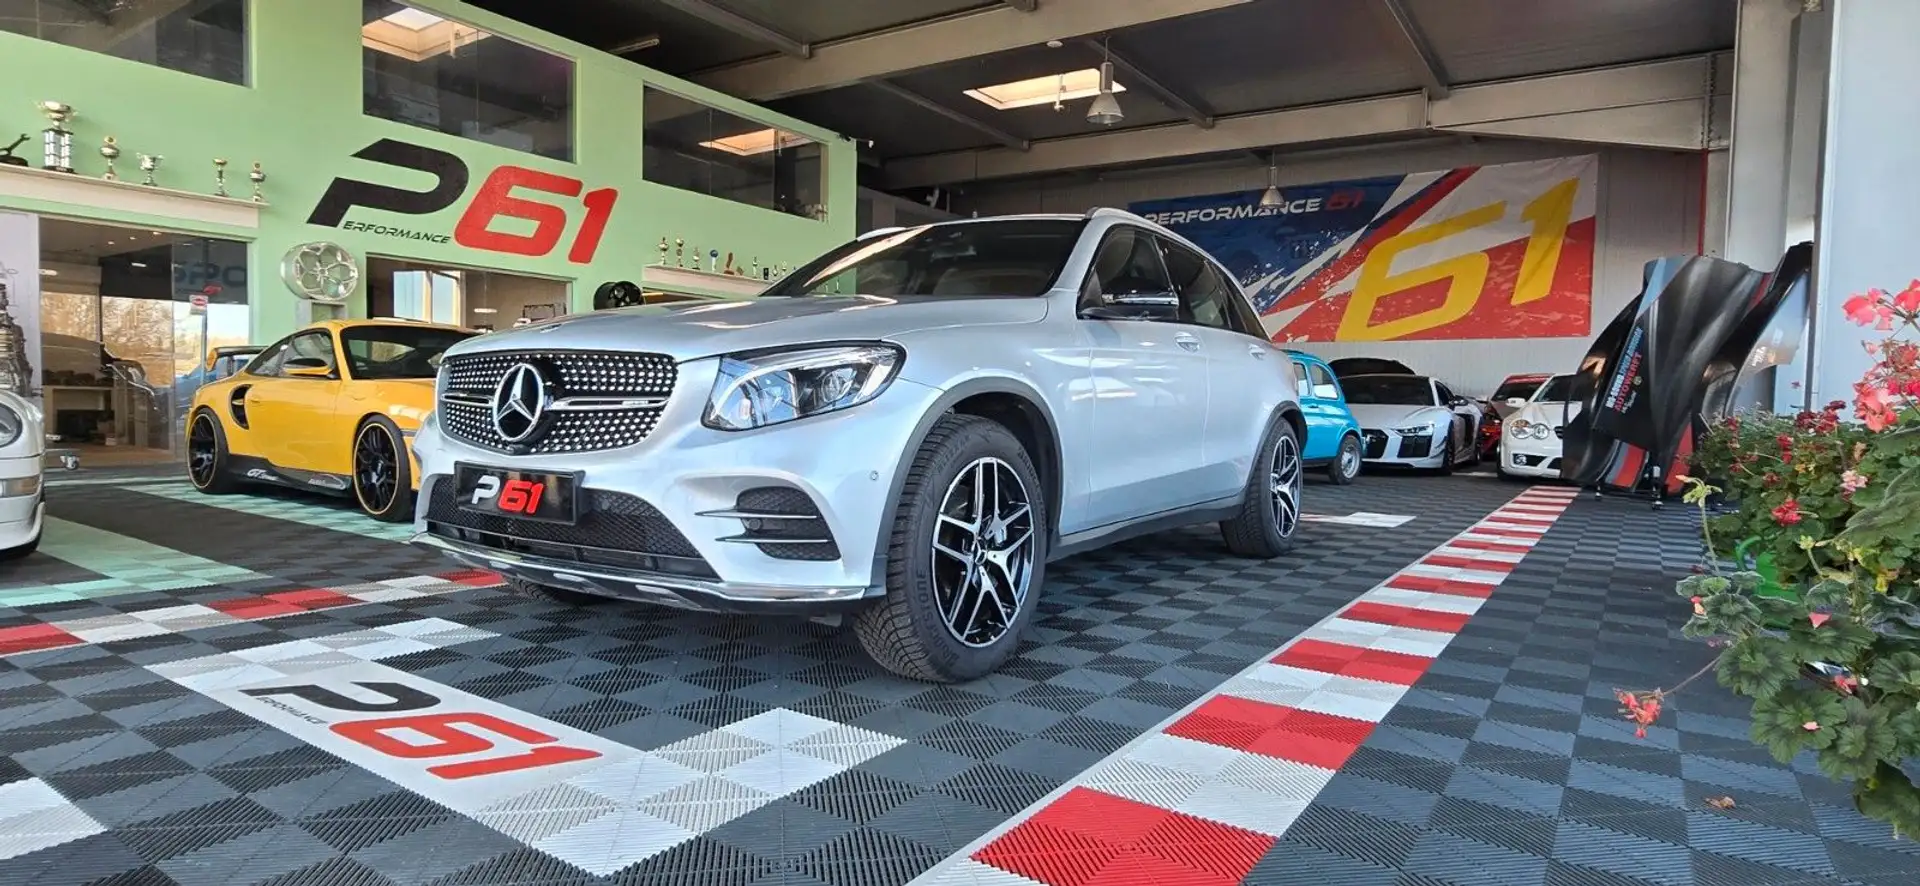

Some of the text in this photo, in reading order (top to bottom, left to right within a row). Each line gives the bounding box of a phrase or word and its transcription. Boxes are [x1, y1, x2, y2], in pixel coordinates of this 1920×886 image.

[306, 138, 619, 264] P61
[1335, 177, 1580, 343] 61
[471, 475, 545, 514] P61
